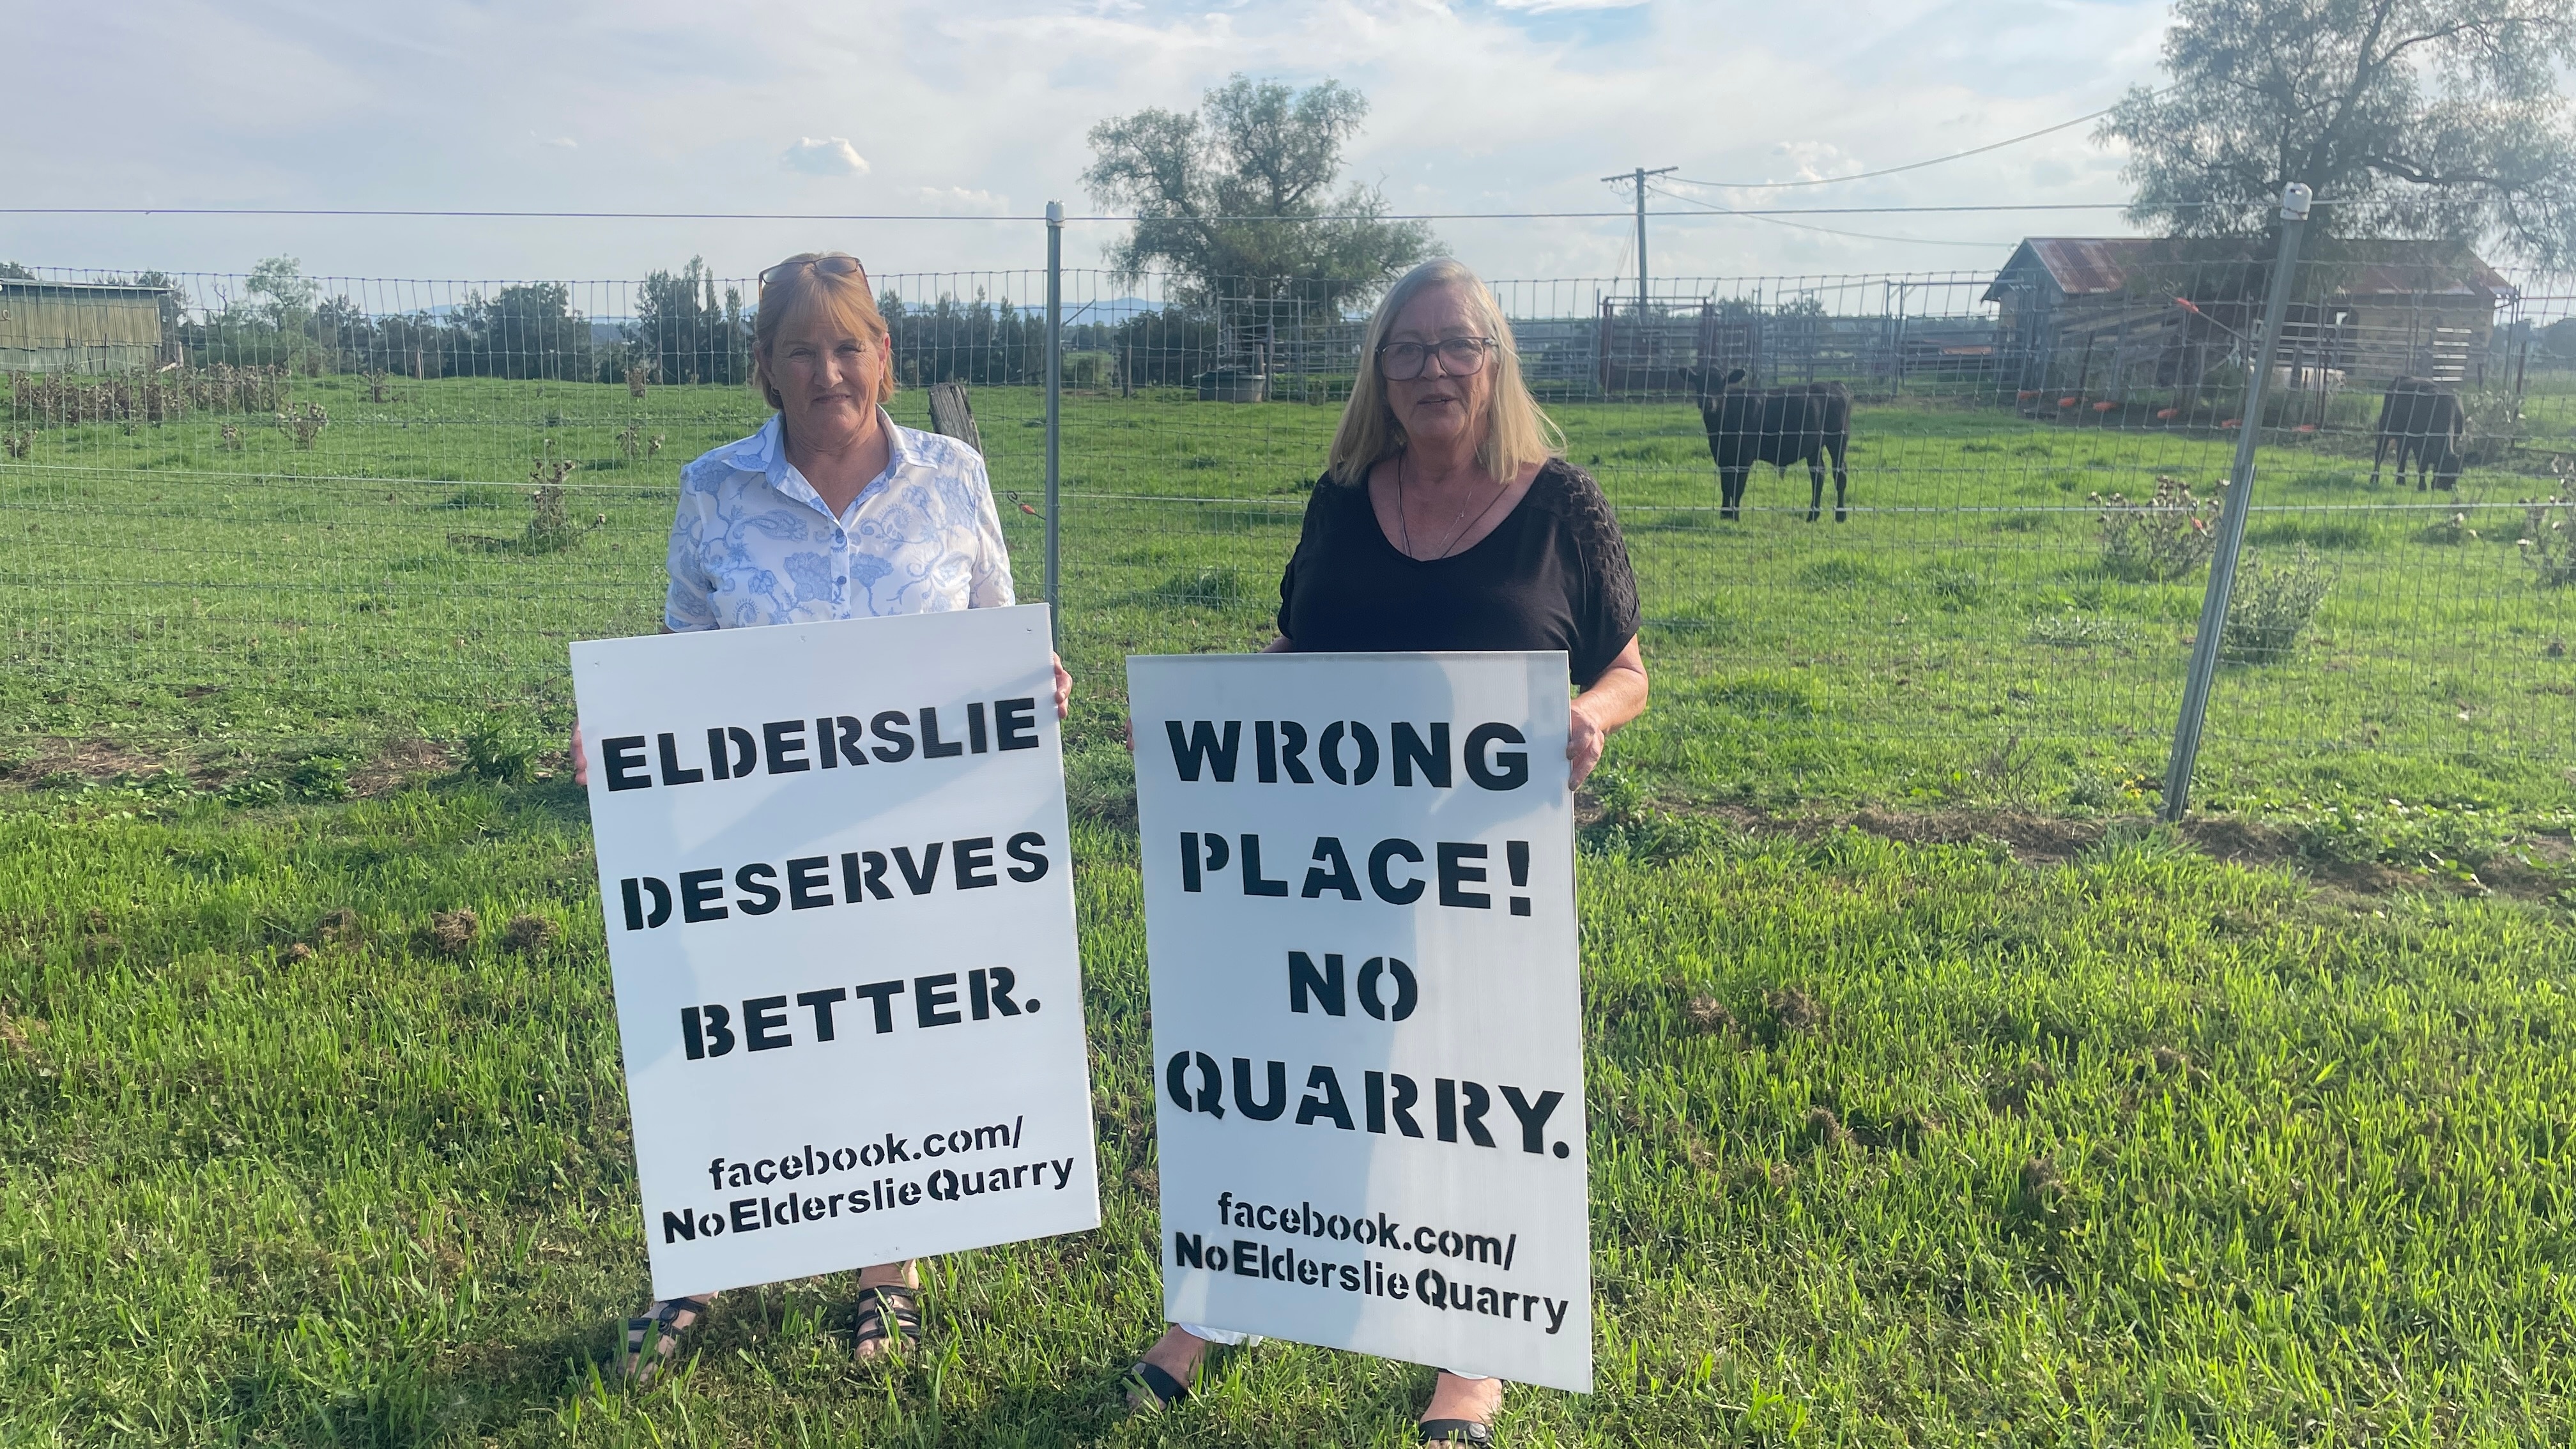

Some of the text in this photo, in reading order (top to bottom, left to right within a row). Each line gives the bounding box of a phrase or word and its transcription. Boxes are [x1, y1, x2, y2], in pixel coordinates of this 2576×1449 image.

[601, 697, 1039, 792] ELDERSLIE
[1164, 720, 1529, 792] WRONG
[620, 831, 1049, 931] DESERVES
[1180, 831, 1531, 917] PLACE!
[680, 967, 1041, 1061] BETTER.
[1287, 951, 1418, 1022] NO
[1166, 1050, 1570, 1159] QUARRY.
[708, 1115, 1023, 1190] facebook.com/
[663, 1157, 1074, 1244] NoElderslieQuarry
[1217, 1192, 1517, 1271] facebook.com/
[1175, 1231, 1569, 1335] NoElderslieQuarry
